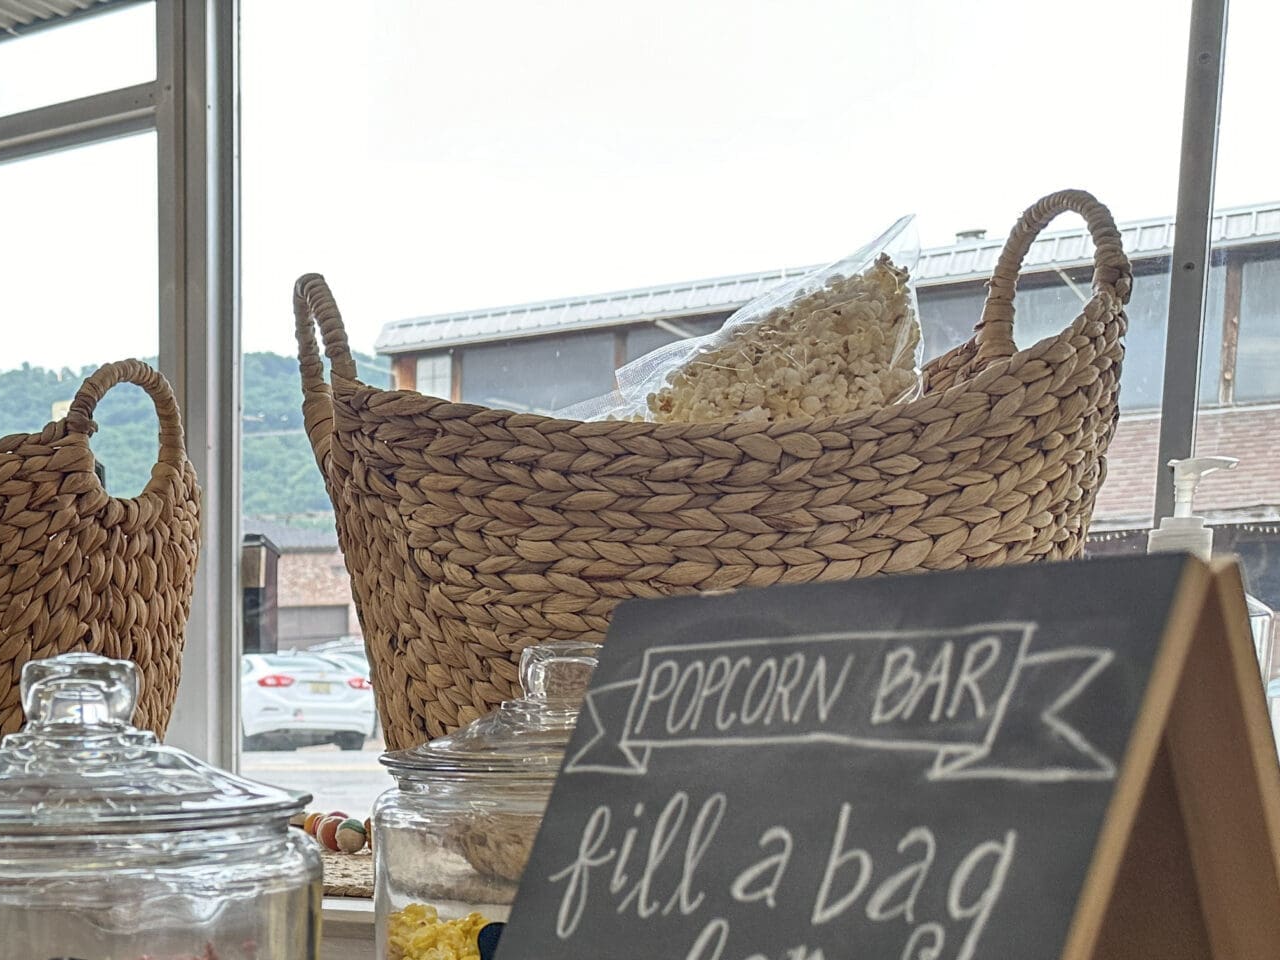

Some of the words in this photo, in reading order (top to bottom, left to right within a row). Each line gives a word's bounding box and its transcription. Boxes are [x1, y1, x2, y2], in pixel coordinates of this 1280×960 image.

[634, 653, 854, 735] POPCORN
[871, 636, 1002, 725] BAR
[549, 792, 727, 938] fill
[730, 826, 793, 908] a
